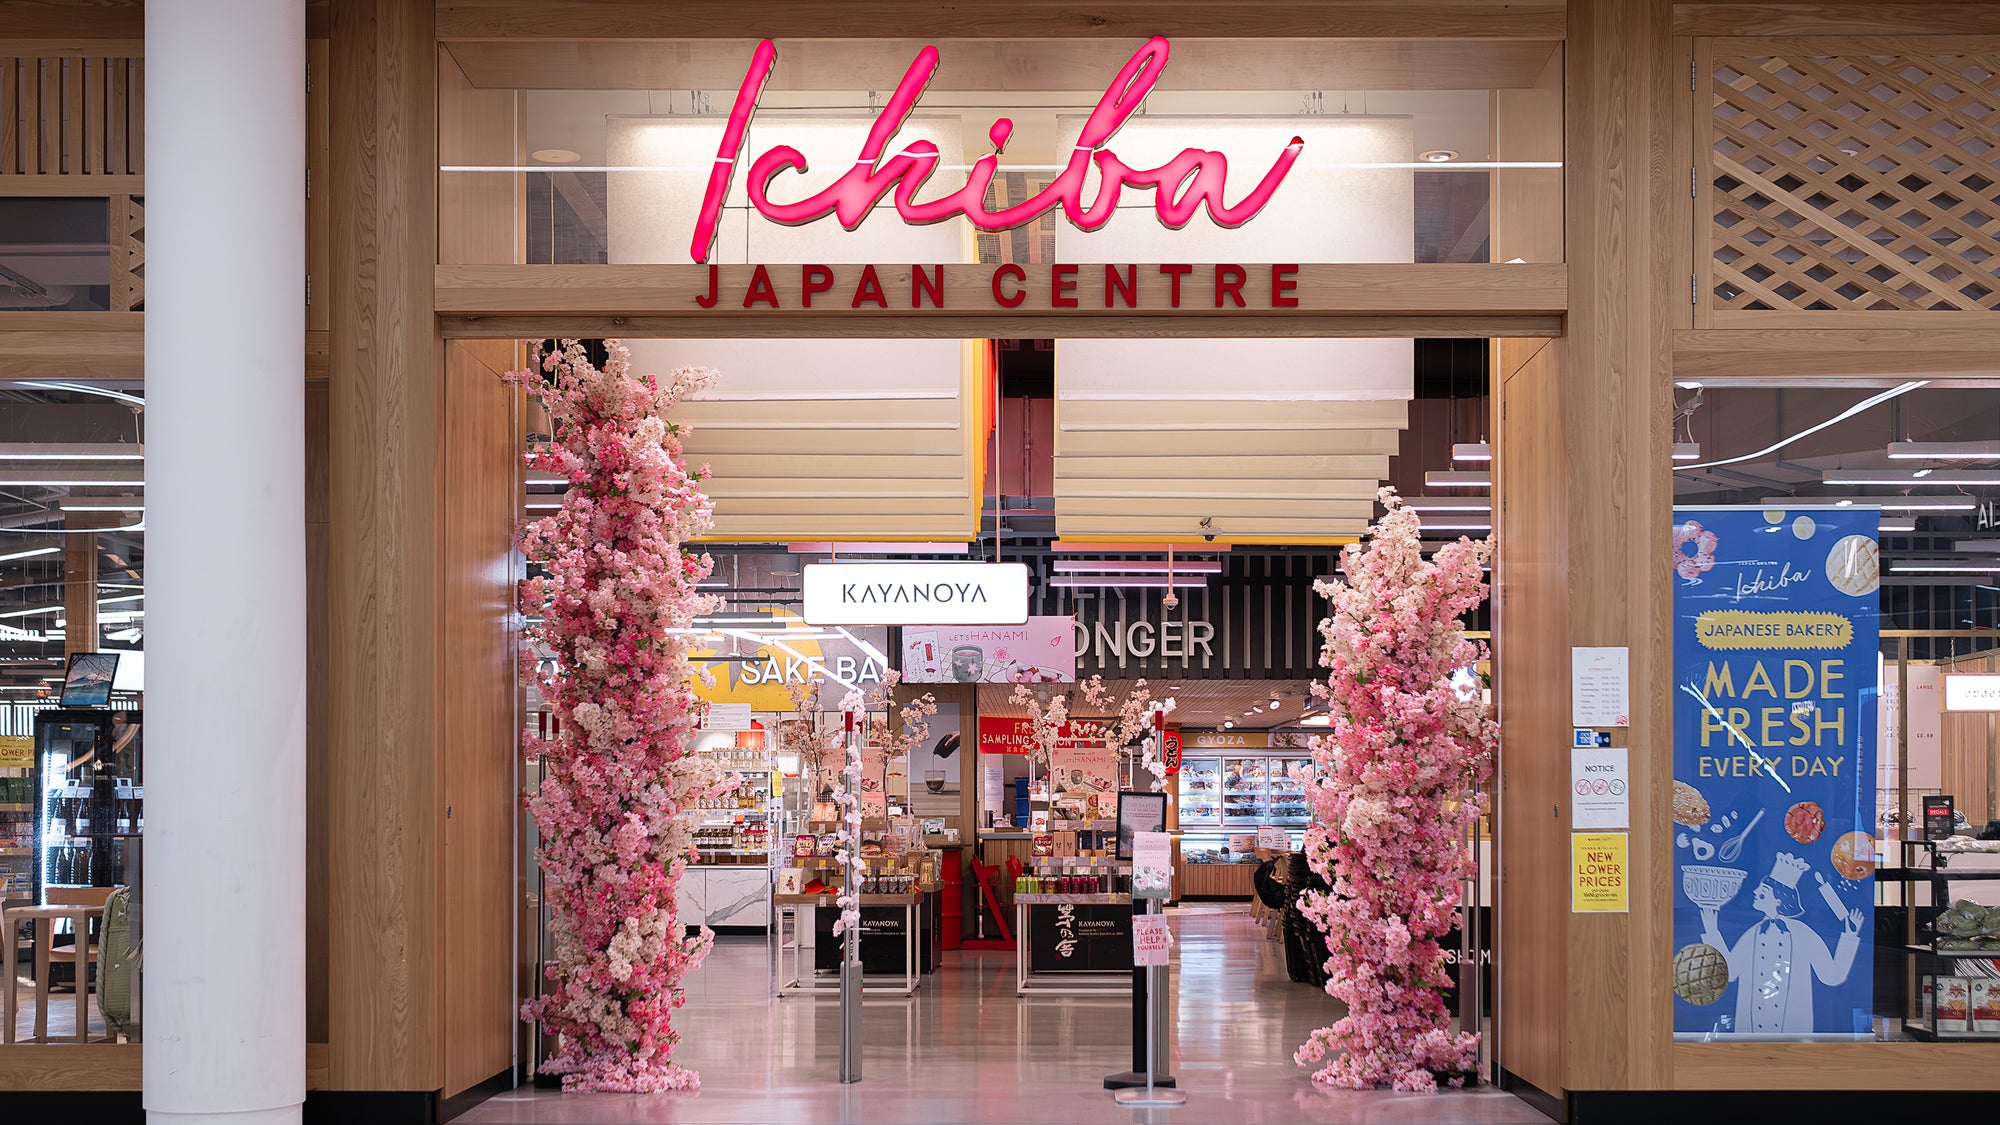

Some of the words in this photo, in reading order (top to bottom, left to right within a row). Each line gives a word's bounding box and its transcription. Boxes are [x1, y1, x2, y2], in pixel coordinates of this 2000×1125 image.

[690, 36, 1304, 264] Ichiba
[695, 264, 945, 309] JAPAN
[992, 264, 1299, 309] CENTRE
[1736, 561, 1812, 602] Ichiba
[842, 583, 987, 603] KAYANOYA
[970, 631, 1028, 641] HANAMI
[1704, 623, 1781, 637] JAPANESE
[1785, 623, 1844, 637] BAKERY
[740, 656, 825, 685] SAKE
[836, 656, 889, 684] BA
[1703, 659, 1845, 699] MADE
[1700, 707, 1845, 747] FRESH
[982, 733, 1030, 746] SAMPLING
[1196, 735, 1245, 745] GYOZA
[0, 748, 25, 757] OWER
[1165, 736, 1179, 768] うどん
[1584, 764, 1615, 773] NOTICE
[1699, 756, 1783, 778] EVERY
[1791, 756, 1845, 778] DAY
[1587, 852, 1613, 863] NEW
[1578, 864, 1622, 875] LOWER
[1579, 876, 1622, 888] PRICES
[862, 920, 900, 928] KAYANOYA
[1078, 920, 1116, 928] KAYANOYA
[1136, 927, 1163, 935] PLEASE
[1139, 935, 1161, 944] HELP
